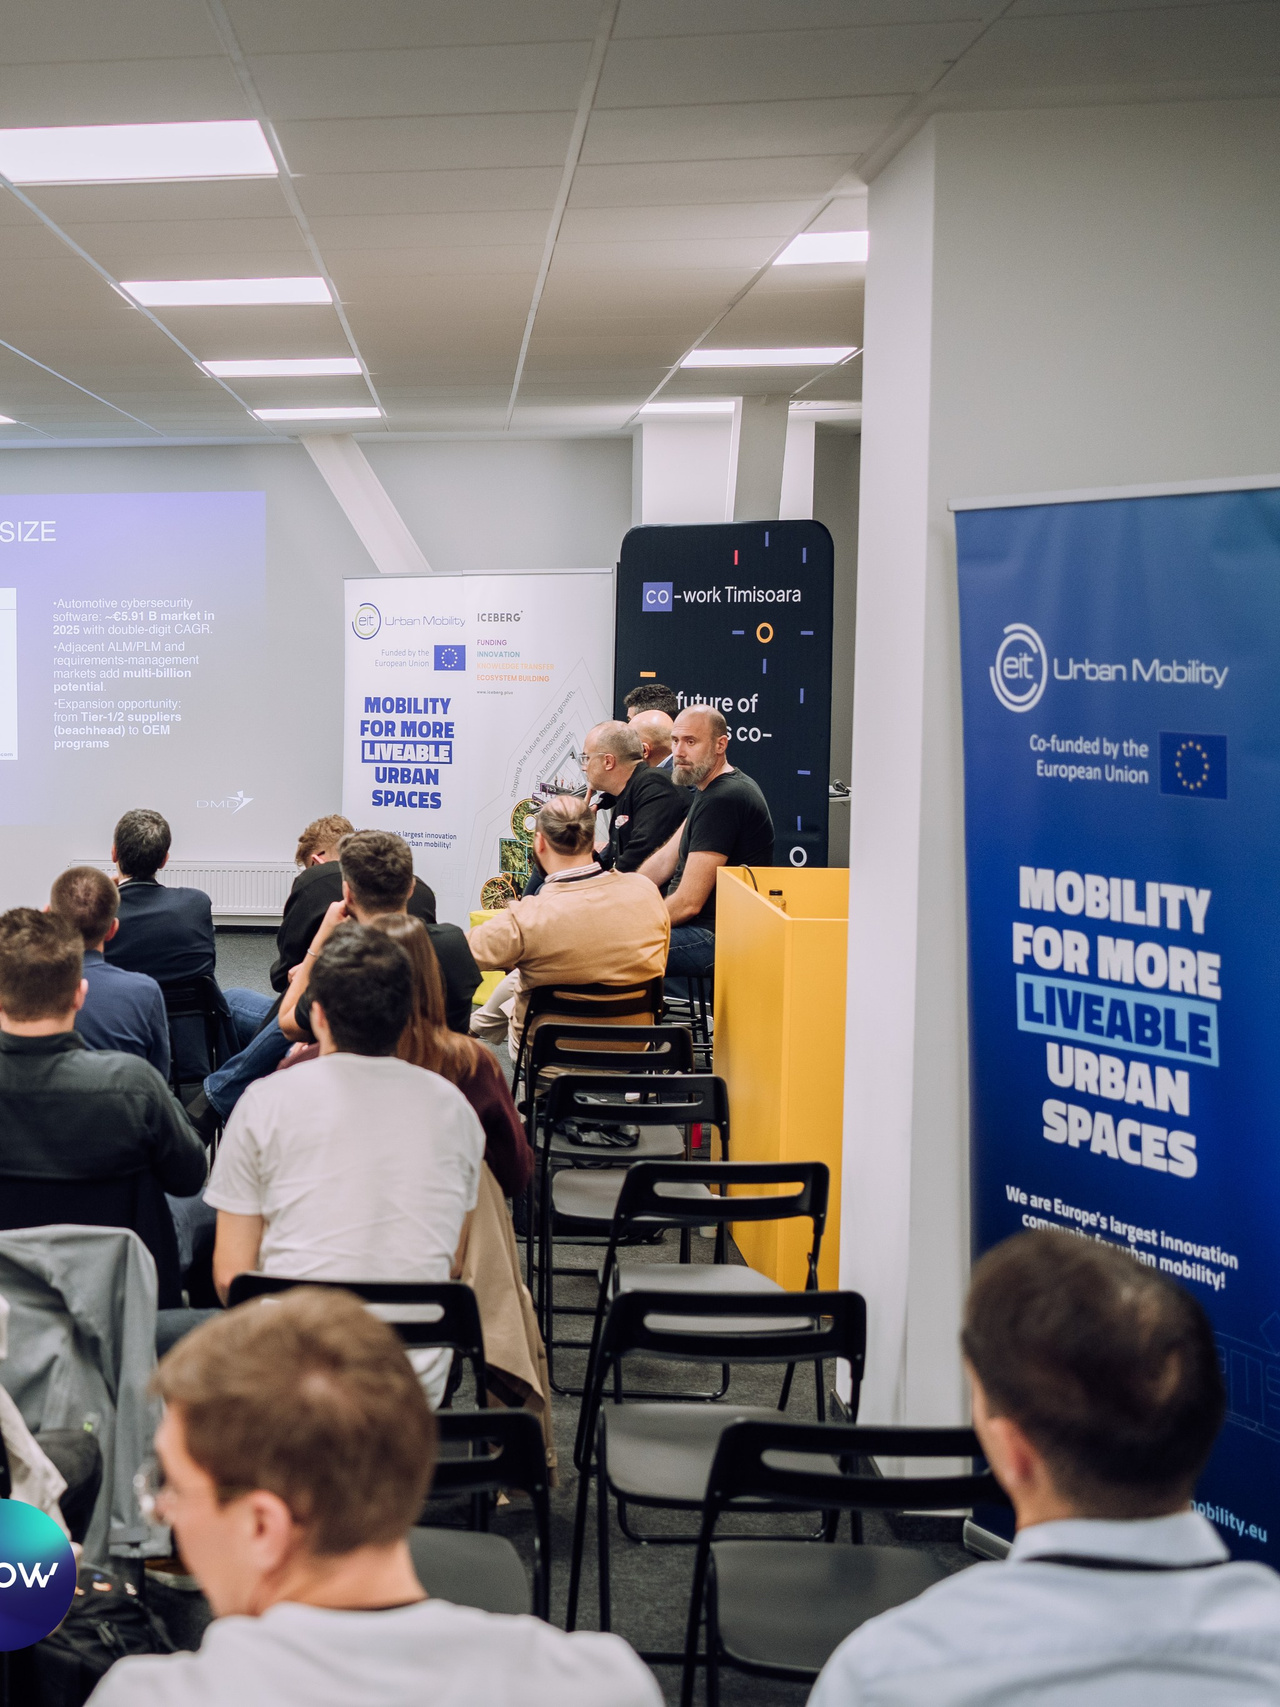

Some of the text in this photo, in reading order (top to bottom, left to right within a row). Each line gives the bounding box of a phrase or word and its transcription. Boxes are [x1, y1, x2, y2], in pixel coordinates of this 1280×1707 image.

[725, 586, 802, 603] Timisoara
[120, 597, 193, 610] cybersecurity
[53, 612, 102, 622] software:
[148, 611, 157, 621] B
[160, 611, 201, 621] market
[204, 611, 215, 621] in
[384, 615, 421, 626] Urban
[422, 615, 466, 627] Mobility
[477, 612, 520, 622] ICEBERG
[53, 623, 213, 637] 2025 with double-digit CAGR.
[107, 641, 161, 652] ALM/PLM
[164, 641, 185, 652] and
[407, 649, 416, 658] by
[53, 655, 200, 667] requirements-management
[374, 660, 407, 668] European
[53, 668, 192, 679] markets add multi-billion
[476, 674, 517, 682] ECOSYSTEM
[1053, 657, 1127, 682] Urban
[1131, 658, 1229, 689] Mobility
[53, 682, 107, 694] potential.
[117, 699, 181, 710] opportunity:
[364, 696, 452, 715] MOBILITY
[737, 693, 759, 713] of
[53, 711, 182, 723] from Tier-1/2 suppliers
[53, 724, 170, 737] (beachhead) to OEM
[360, 719, 455, 738] FOR MORE
[736, 726, 772, 742] co-
[54, 740, 110, 750] programs
[541, 721, 567, 754] innovation
[363, 742, 451, 763] LIVEABLE
[510, 766, 522, 798] Shaping
[518, 754, 527, 766] the
[525, 736, 541, 756] future
[538, 712, 559, 737] through
[1029, 734, 1149, 760] Co-funded by the
[539, 752, 560, 776] human
[1036, 760, 1149, 784] European Union
[374, 766, 439, 785] URBAN
[371, 789, 442, 809] SPACES
[402, 830, 424, 839] largest
[424, 832, 457, 840] innovation
[423, 841, 451, 849] mobility!
[1019, 865, 1212, 935] MOBILITY
[1012, 921, 1222, 1001] FOR MORE
[1023, 981, 1212, 1060] LIVEABLE
[1046, 1041, 1190, 1117] URBAN
[1041, 1098, 1198, 1179] SPACES
[1005, 1184, 1028, 1205] We
[1030, 1194, 1052, 1212] are
[1053, 1197, 1108, 1230] Europe's
[1110, 1215, 1158, 1246] largest
[1160, 1230, 1239, 1270] innovation
[1159, 1256, 1227, 1292] mobility!
